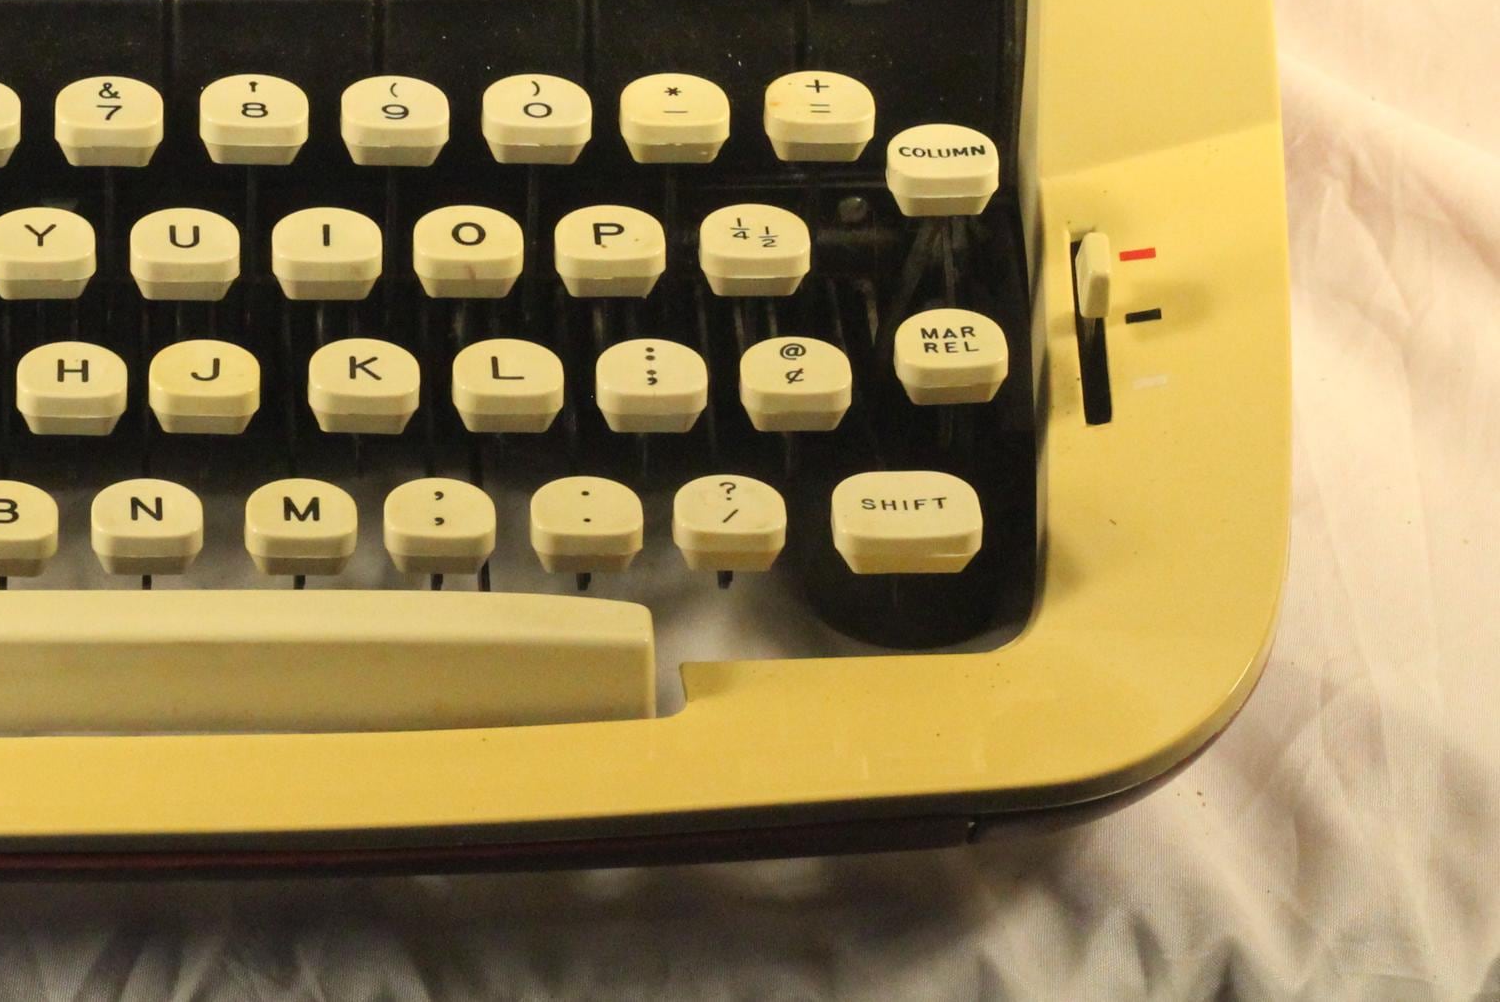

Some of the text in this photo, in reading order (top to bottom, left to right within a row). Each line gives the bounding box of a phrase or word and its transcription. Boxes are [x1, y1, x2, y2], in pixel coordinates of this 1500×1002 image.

[98, 82, 121, 100] &
[806, 79, 829, 94] +
[96, 104, 123, 121] 7
[241, 102, 269, 119] 8
[381, 104, 410, 120] 9
[898, 144, 986, 159] COLUMN
[24, 223, 57, 247] Y
[168, 224, 200, 249] U
[322, 223, 331, 247] I
[451, 221, 487, 247] O
[592, 222, 625, 246] P
[920, 325, 976, 340] MAR
[779, 342, 807, 361] @
[923, 341, 979, 354] REL
[57, 358, 89, 383] H
[190, 357, 221, 382] J
[348, 355, 382, 381] K
[490, 355, 525, 381] L
[719, 481, 737, 501] ?
[130, 496, 163, 522] N
[282, 496, 321, 522] M
[861, 496, 947, 511] SHIFT
